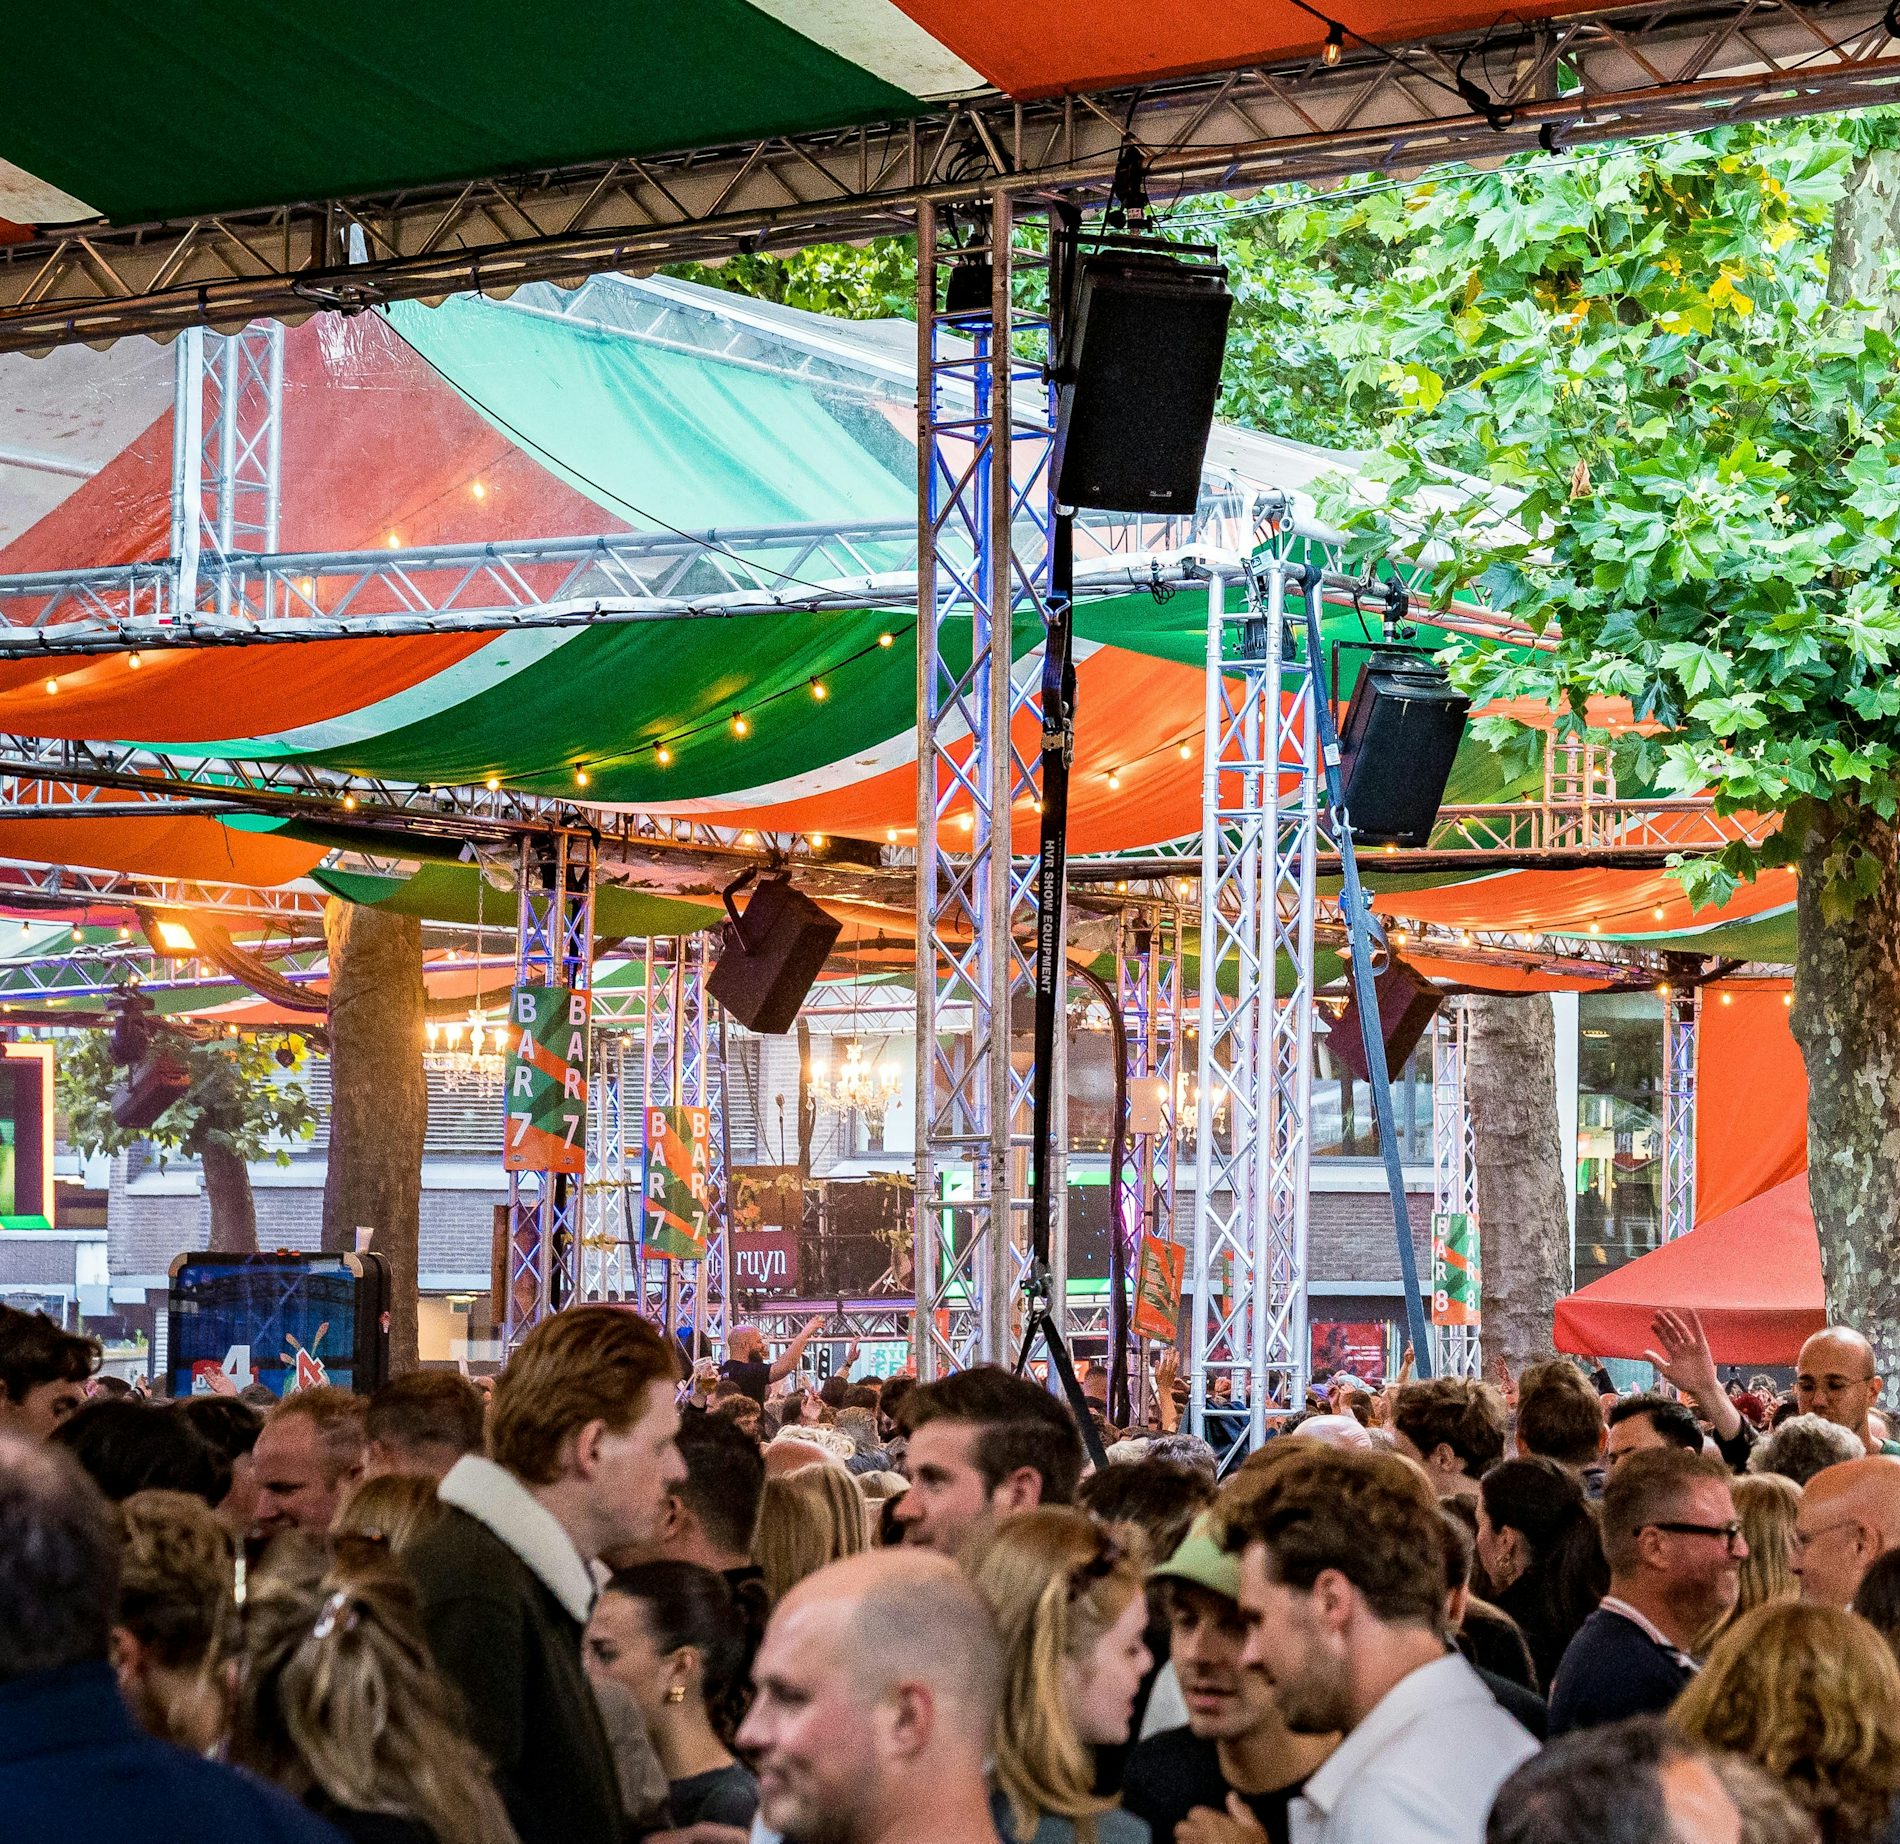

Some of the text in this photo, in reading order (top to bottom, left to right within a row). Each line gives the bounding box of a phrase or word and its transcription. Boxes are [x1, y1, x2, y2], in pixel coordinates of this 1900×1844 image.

[1042, 871, 1055, 911] SHOW
[1040, 914, 1054, 994] EQUIPMENT
[513, 993, 537, 1098] BAR
[564, 995, 586, 1100] BAR
[511, 1112, 533, 1147] 7
[563, 1114, 580, 1149] 7
[649, 1112, 667, 1241] BAR 7
[691, 1112, 708, 1241] BAR 7
[1434, 1217, 1449, 1312] BAR 8
[1466, 1216, 1476, 1311] BAR 8
